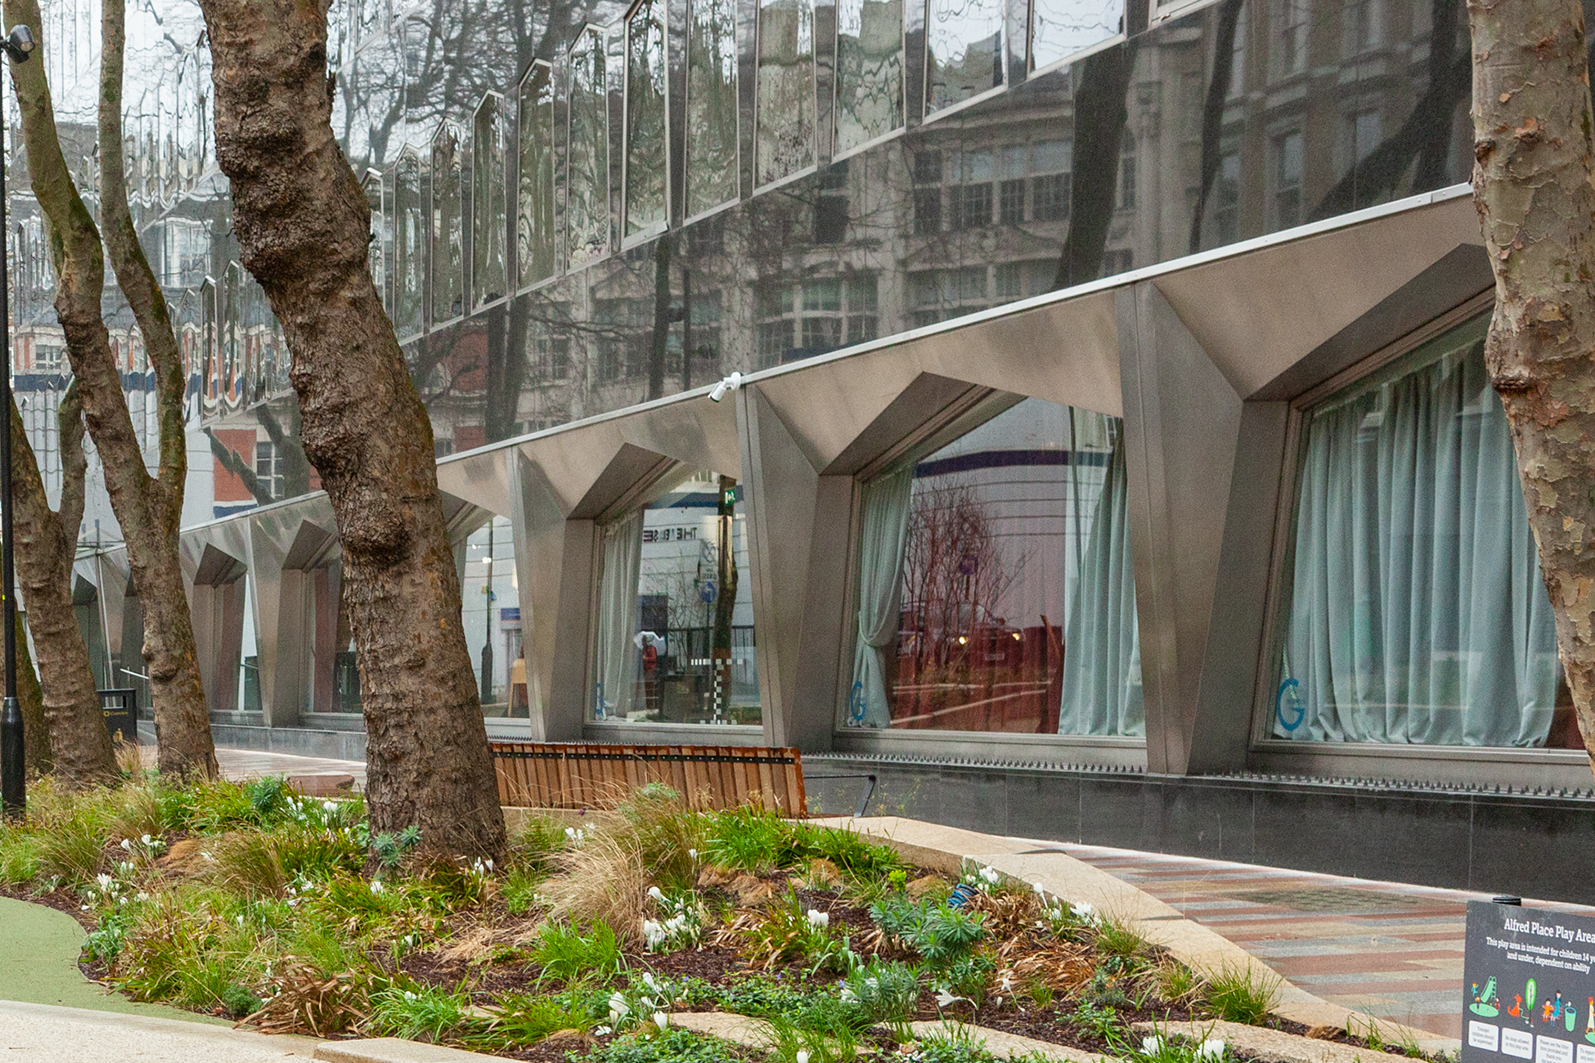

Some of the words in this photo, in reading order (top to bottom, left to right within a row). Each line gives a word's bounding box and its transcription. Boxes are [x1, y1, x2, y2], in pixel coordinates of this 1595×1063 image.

[1504, 918, 1530, 934] Alfred
[1531, 922, 1554, 938] Place
[1555, 926, 1575, 943] Play
[1486, 937, 1497, 947] This
[1497, 939, 1509, 950] play
[1509, 941, 1520, 950] area
[1526, 944, 1550, 955] intended
[1550, 947, 1559, 957] for
[1559, 949, 1582, 960] children
[1507, 952, 1518, 961] and
[1535, 956, 1564, 967] dependent
[1564, 962, 1573, 970] on
[1573, 963, 1590, 975] ability
